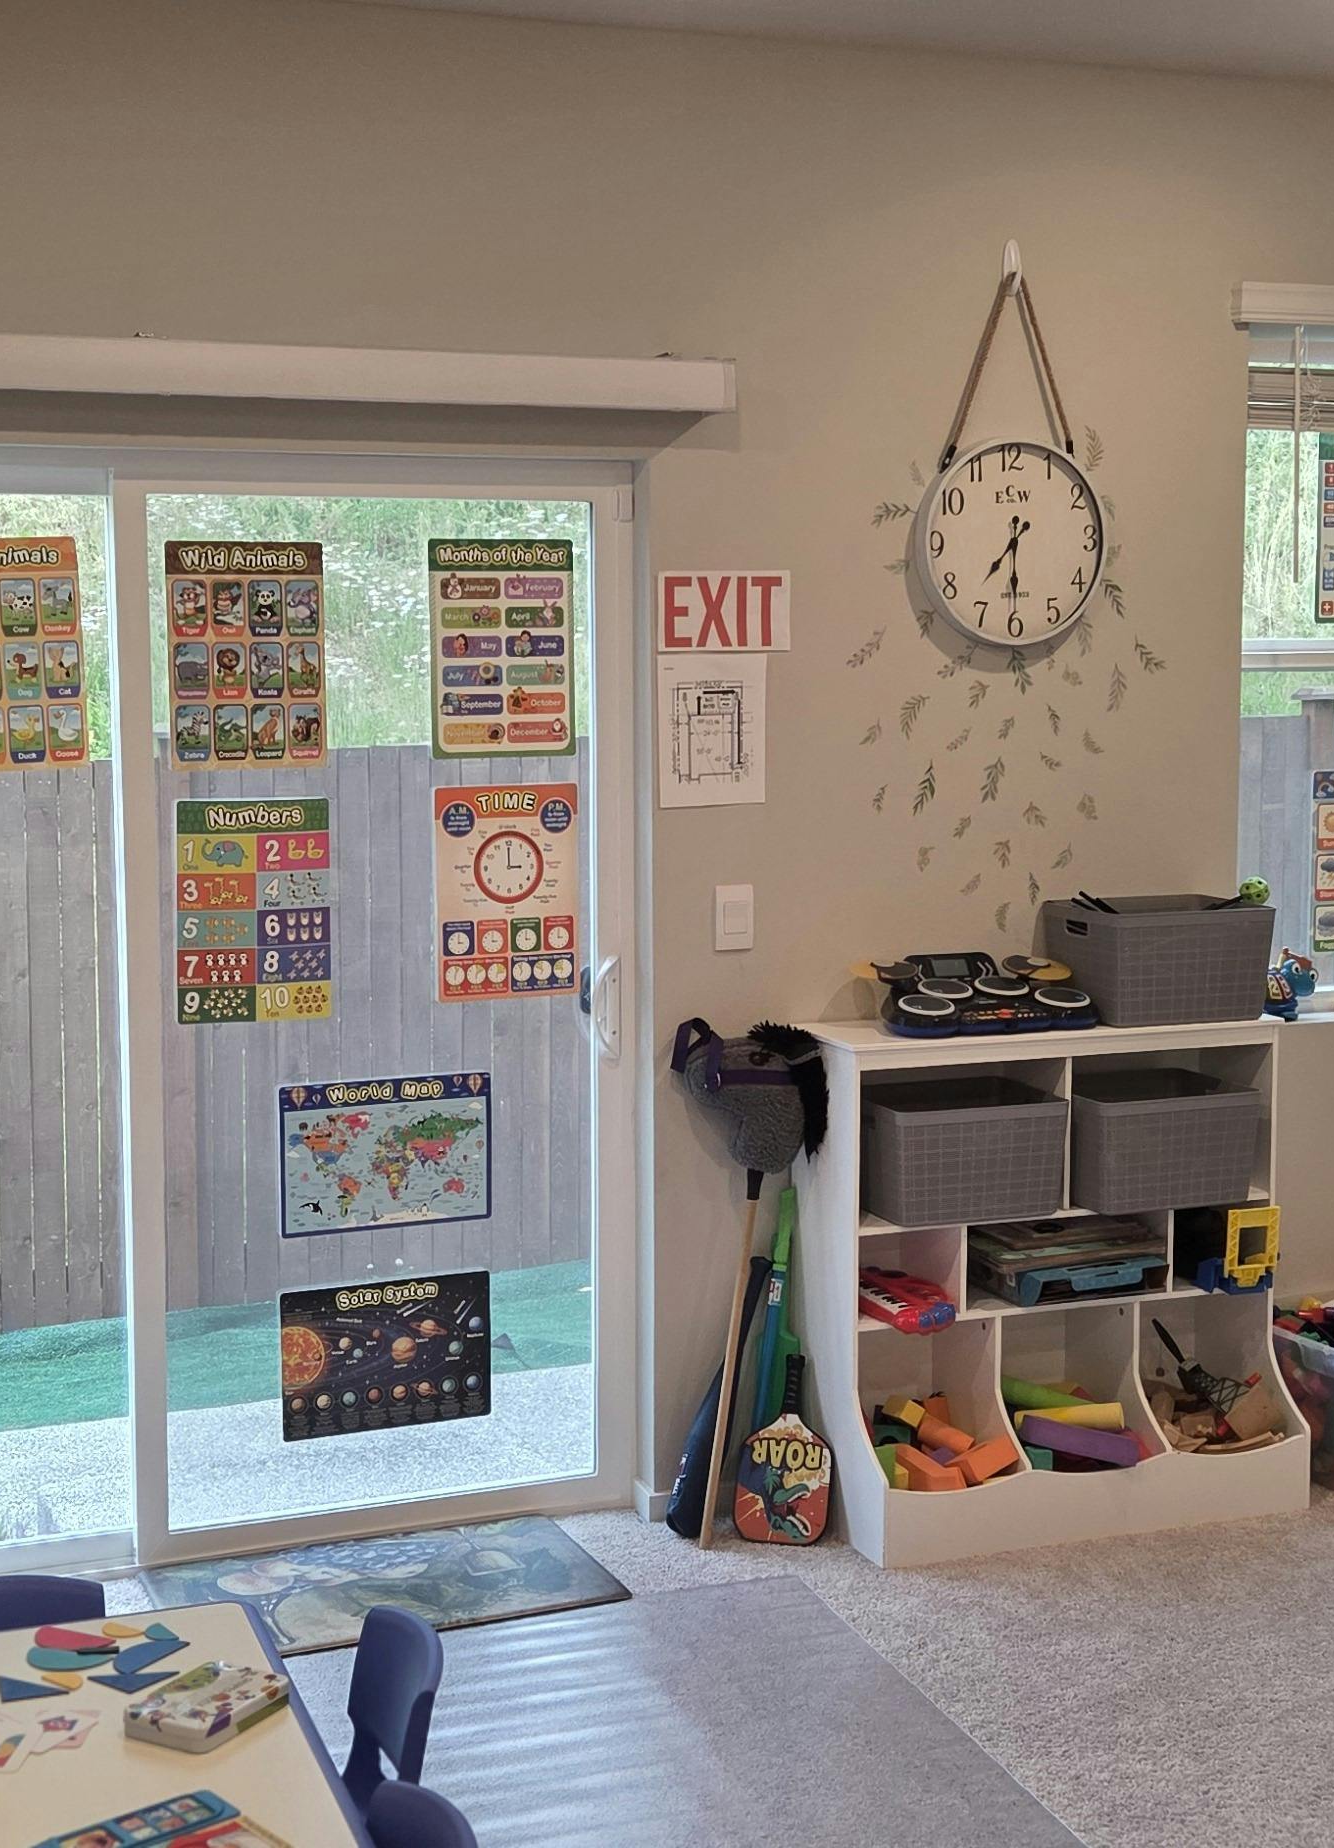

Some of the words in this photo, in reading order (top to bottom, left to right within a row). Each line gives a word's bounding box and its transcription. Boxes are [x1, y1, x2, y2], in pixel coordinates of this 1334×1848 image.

[970, 455, 982, 482] 11
[997, 444, 1024, 472] 12
[1043, 453, 1051, 480] 1
[942, 488, 964, 515] 10
[995, 492, 1003, 503] E
[1006, 485, 1015, 497] C
[1018, 490, 1030, 503] W
[1071, 483, 1087, 510] 2
[930, 531, 944, 558] 9
[1083, 525, 1097, 551] 3
[182, 549, 225, 569] Wild
[232, 547, 305, 568] Animals
[439, 547, 489, 562] Months
[494, 548, 508, 561] of
[512, 548, 533, 563] the
[535, 546, 564, 561] Year
[464, 584, 496, 592] January
[526, 584, 560, 592] February
[943, 572, 957, 599] 8
[1071, 567, 1086, 593] 4
[664, 576, 782, 648] EXIT
[974, 601, 988, 627] 7
[1047, 598, 1060, 624] 5
[1007, 611, 1023, 637] 6
[481, 642, 497, 651] May
[447, 673, 464, 681] July
[511, 672, 538, 680] August
[461, 702, 501, 710] September
[477, 793, 536, 812] TIME
[208, 806, 302, 827] Numbers
[183, 840, 194, 862] 1
[265, 840, 281, 862] 2
[183, 879, 199, 902] 3
[265, 878, 280, 900] 4
[183, 917, 199, 939] 5
[265, 915, 280, 937] 6
[184, 956, 199, 977] 7
[264, 951, 279, 973] 8
[184, 992, 200, 1013] 9
[260, 987, 289, 1010] 10
[327, 1084, 391, 1103] World
[402, 1081, 443, 1097] Map
[338, 1291, 380, 1309] Solar
[384, 1283, 437, 1302] System
[752, 1437, 823, 1471] ROAR
